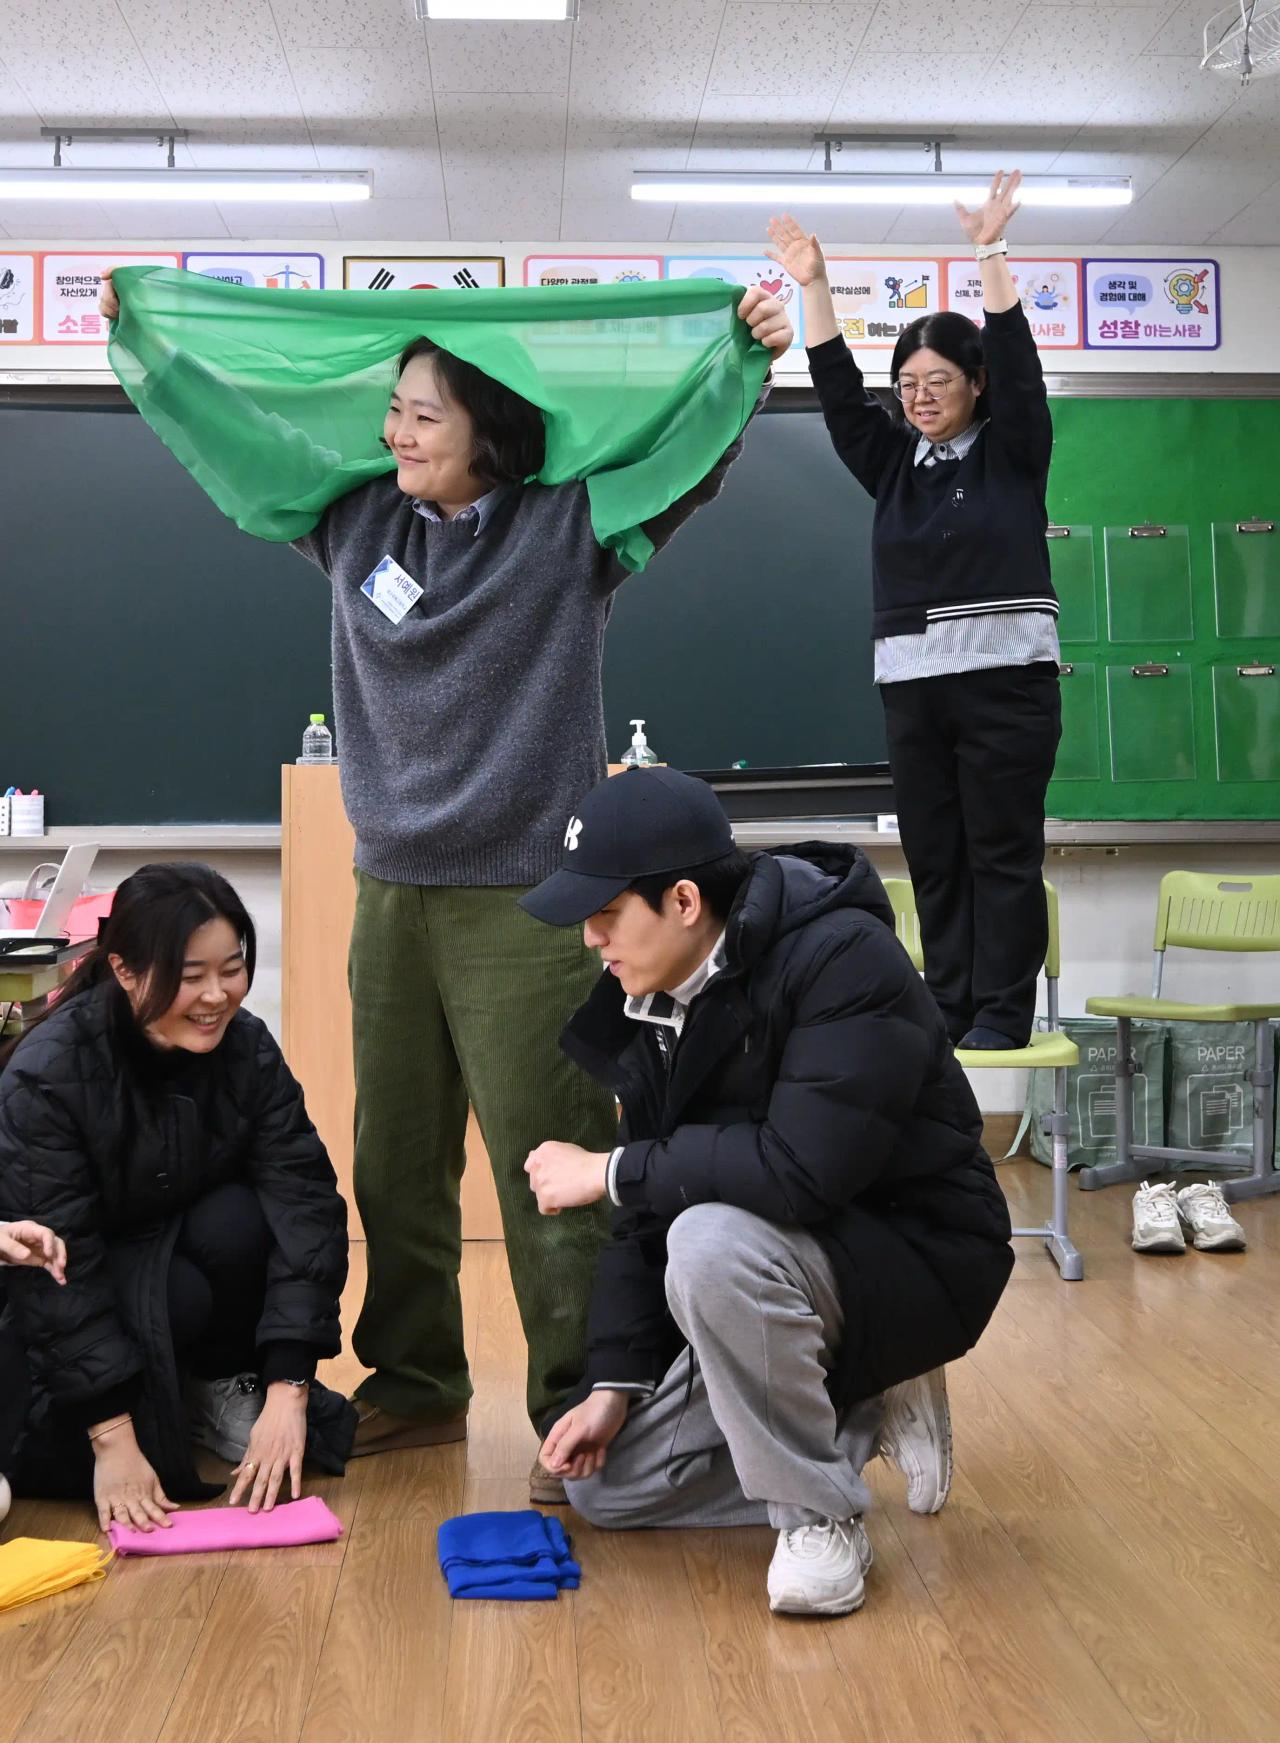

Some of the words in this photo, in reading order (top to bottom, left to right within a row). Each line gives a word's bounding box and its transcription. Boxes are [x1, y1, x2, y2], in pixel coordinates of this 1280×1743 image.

[55, 275, 101, 286] 창의적으로
[1108, 281, 1126, 290] 생각
[1128, 281, 1137, 290] 및
[60, 287, 97, 297] 자신있게
[1099, 292, 1126, 302] 경험에
[1128, 292, 1146, 302] 대해
[57, 314, 101, 334] 소통
[836, 318, 865, 339] 전
[1098, 320, 1140, 339] 성찰
[1143, 324, 1202, 338] 하는사람
[1088, 1047, 1137, 1062] PAPR
[1198, 1046, 1246, 1061] PAPER
